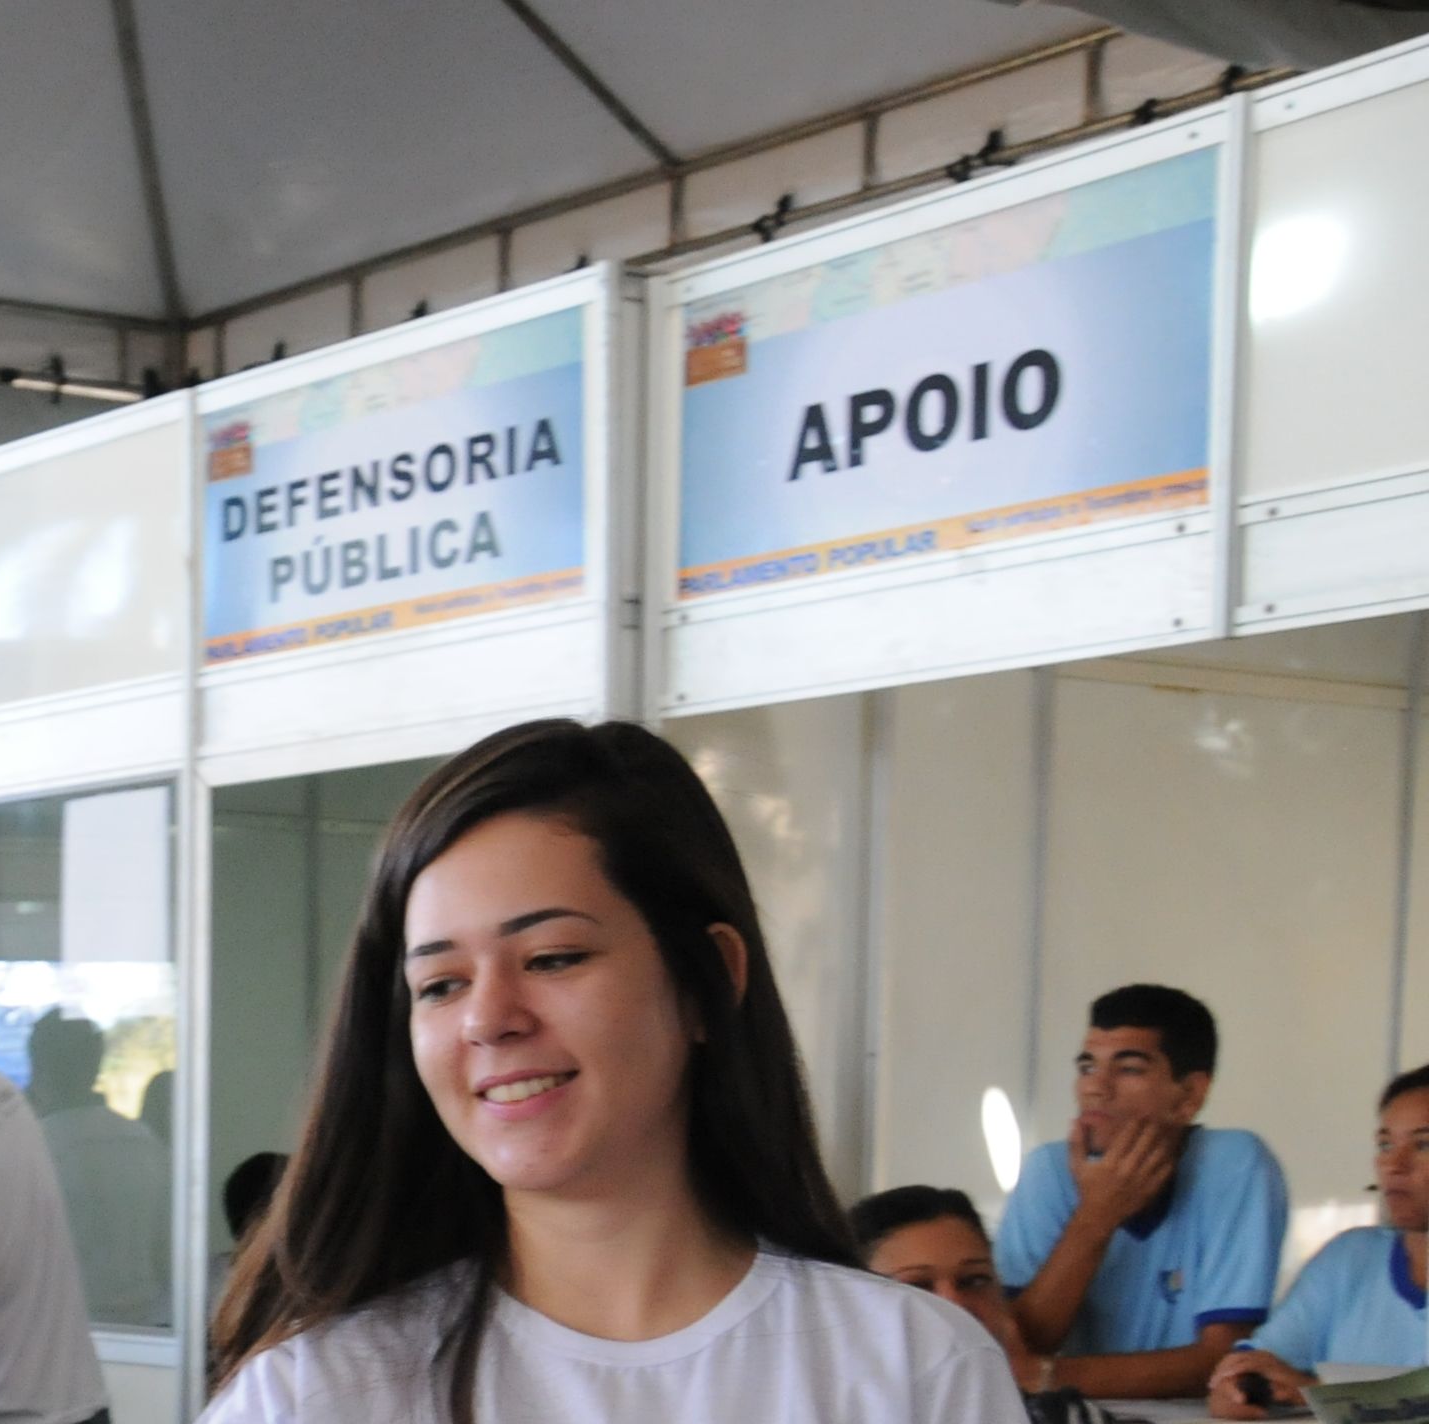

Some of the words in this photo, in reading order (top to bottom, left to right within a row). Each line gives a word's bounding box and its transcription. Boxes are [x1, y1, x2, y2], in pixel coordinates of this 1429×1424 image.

[786, 348, 1063, 482] APOIO
[221, 416, 563, 543] DEFENSORIA
[267, 510, 502, 604] PÚBLICA
